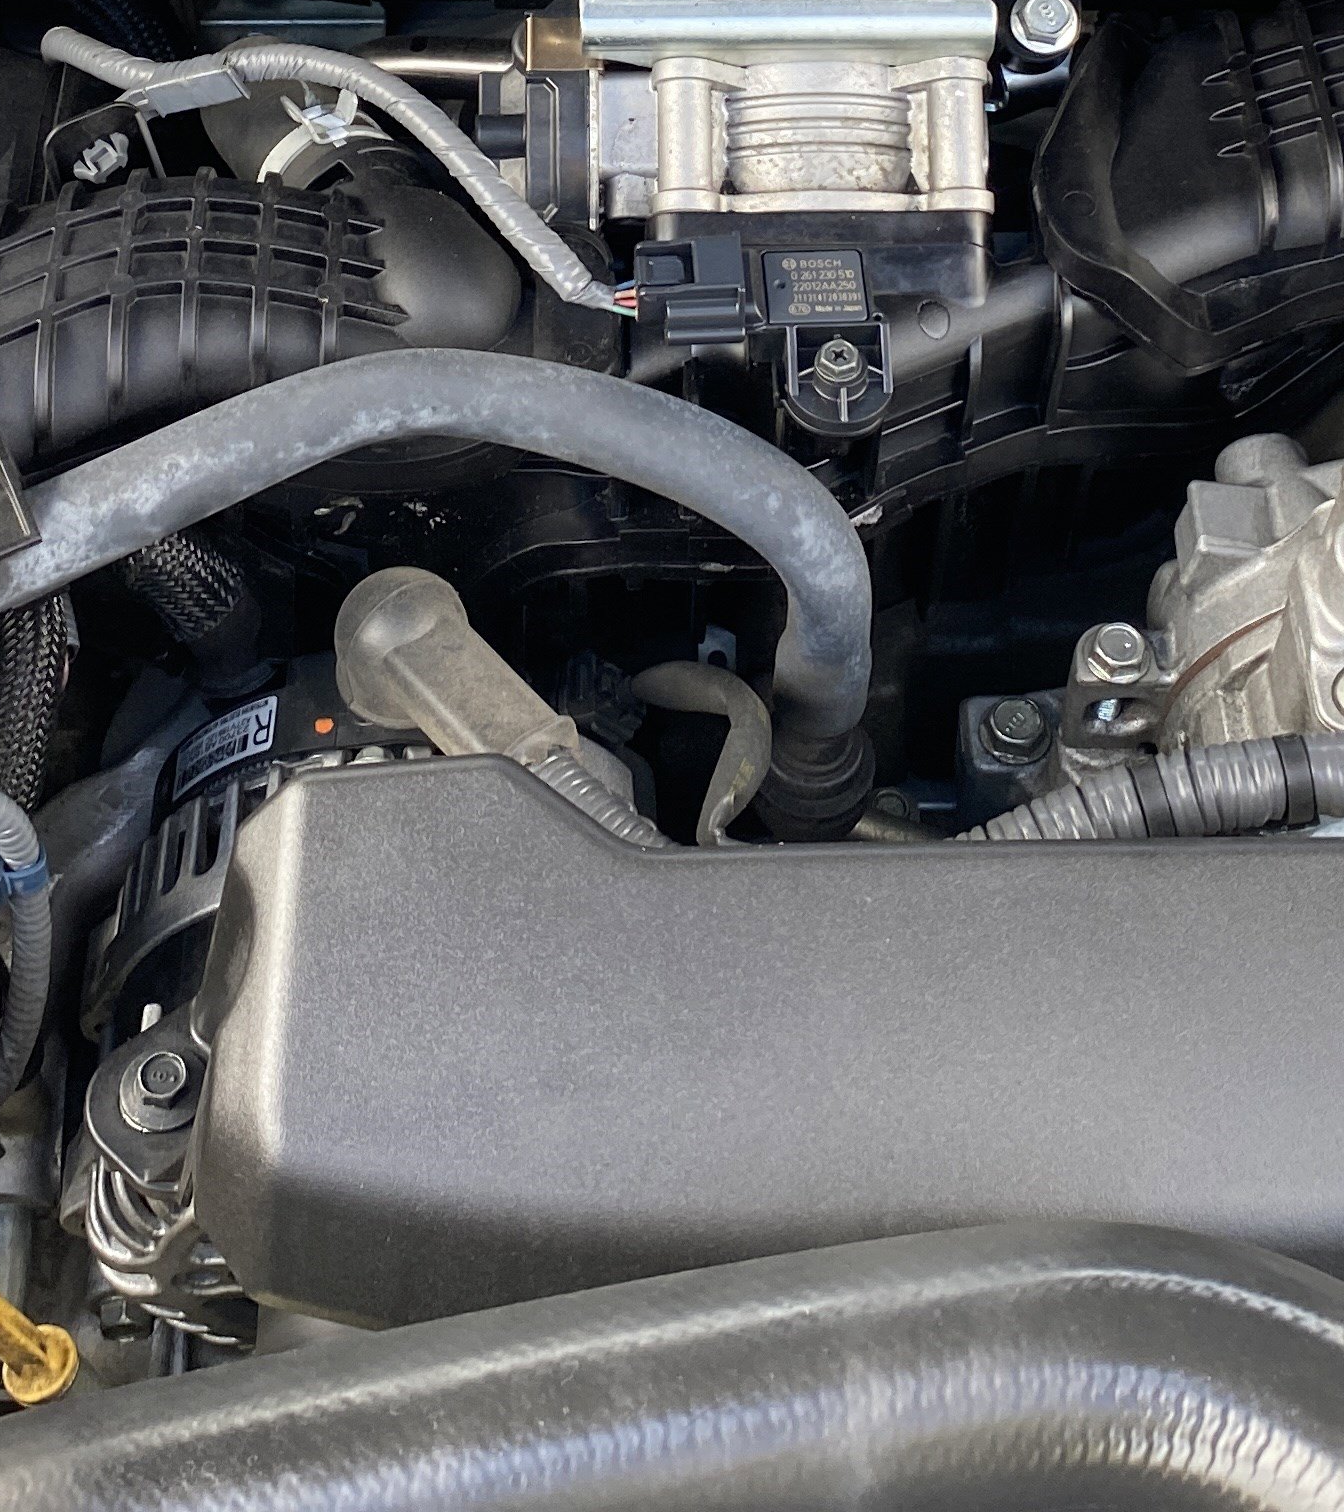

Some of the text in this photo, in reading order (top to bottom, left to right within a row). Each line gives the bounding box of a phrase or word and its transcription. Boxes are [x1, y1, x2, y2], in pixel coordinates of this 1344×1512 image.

[799, 259, 842, 269] BOSCH
[800, 270, 816, 280] 261
[819, 270, 836, 279] 230
[253, 709, 273, 746] R
